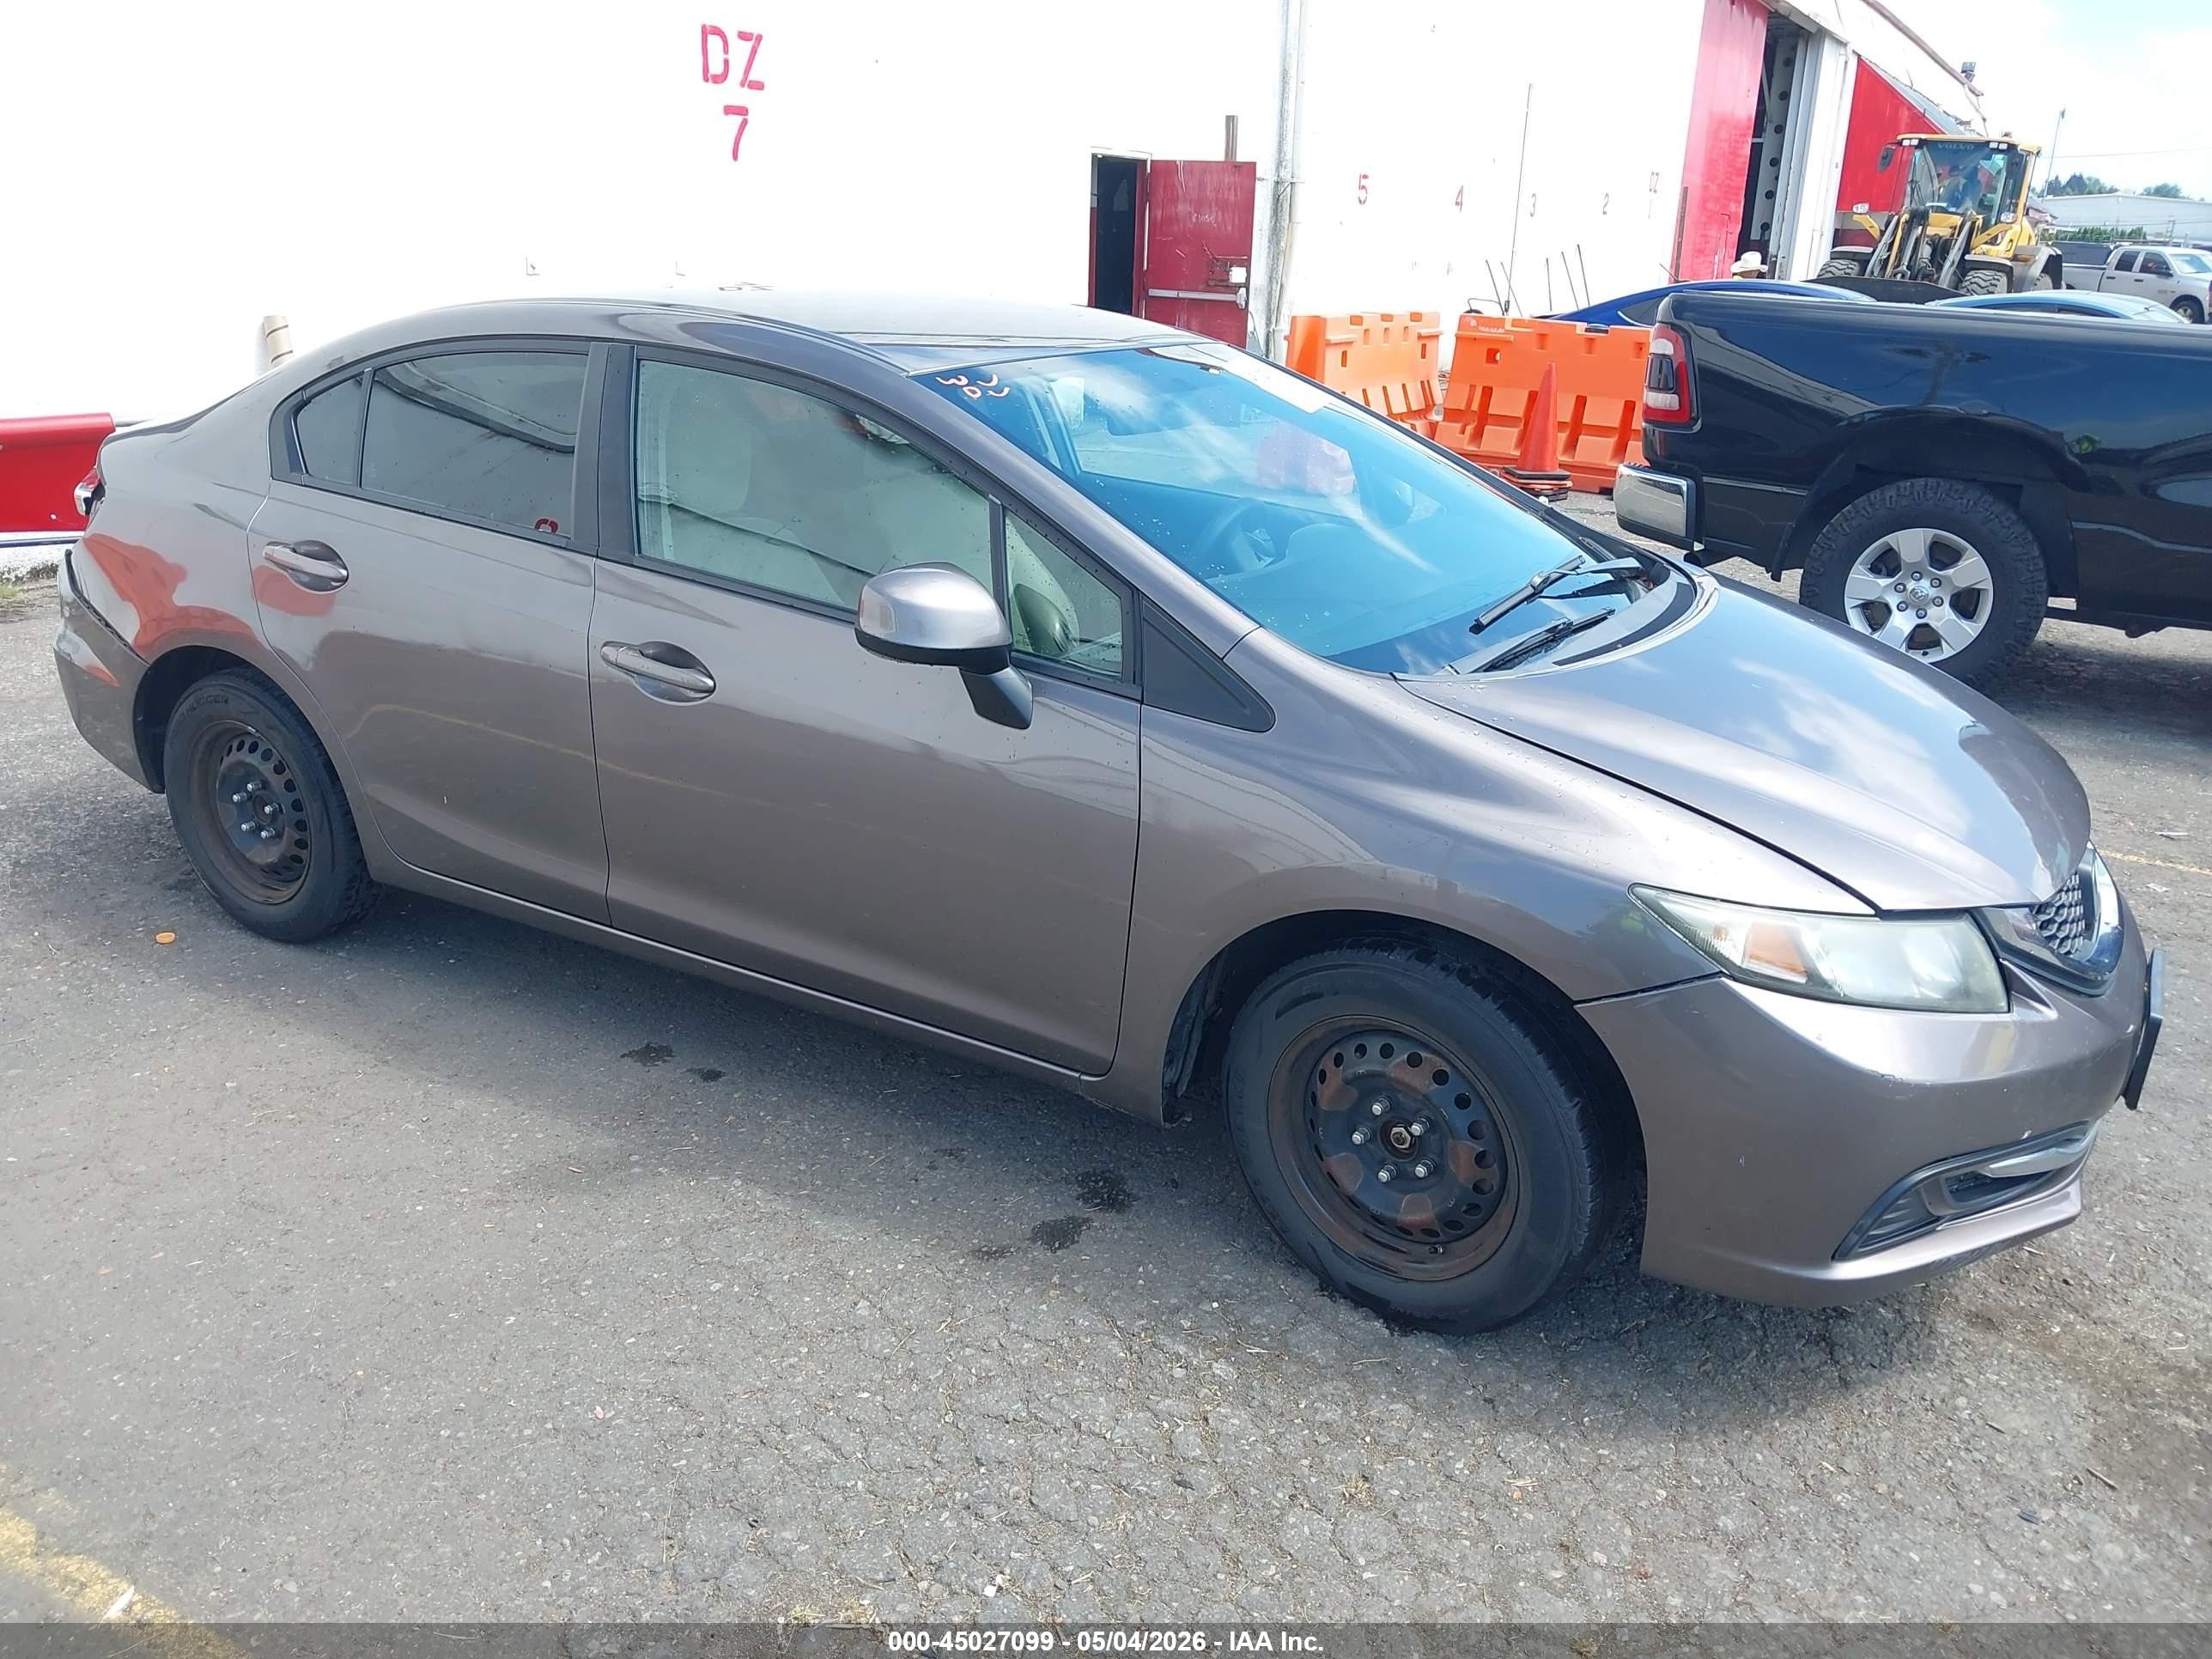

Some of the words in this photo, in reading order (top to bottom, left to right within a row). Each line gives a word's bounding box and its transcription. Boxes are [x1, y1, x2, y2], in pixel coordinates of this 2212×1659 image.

[701, 23, 765, 91] DZ
[723, 105, 749, 161] 7
[1358, 173, 1370, 205] 5
[1455, 185, 1464, 214] 4
[1601, 192, 1610, 216] 2
[1529, 192, 1537, 218] 3
